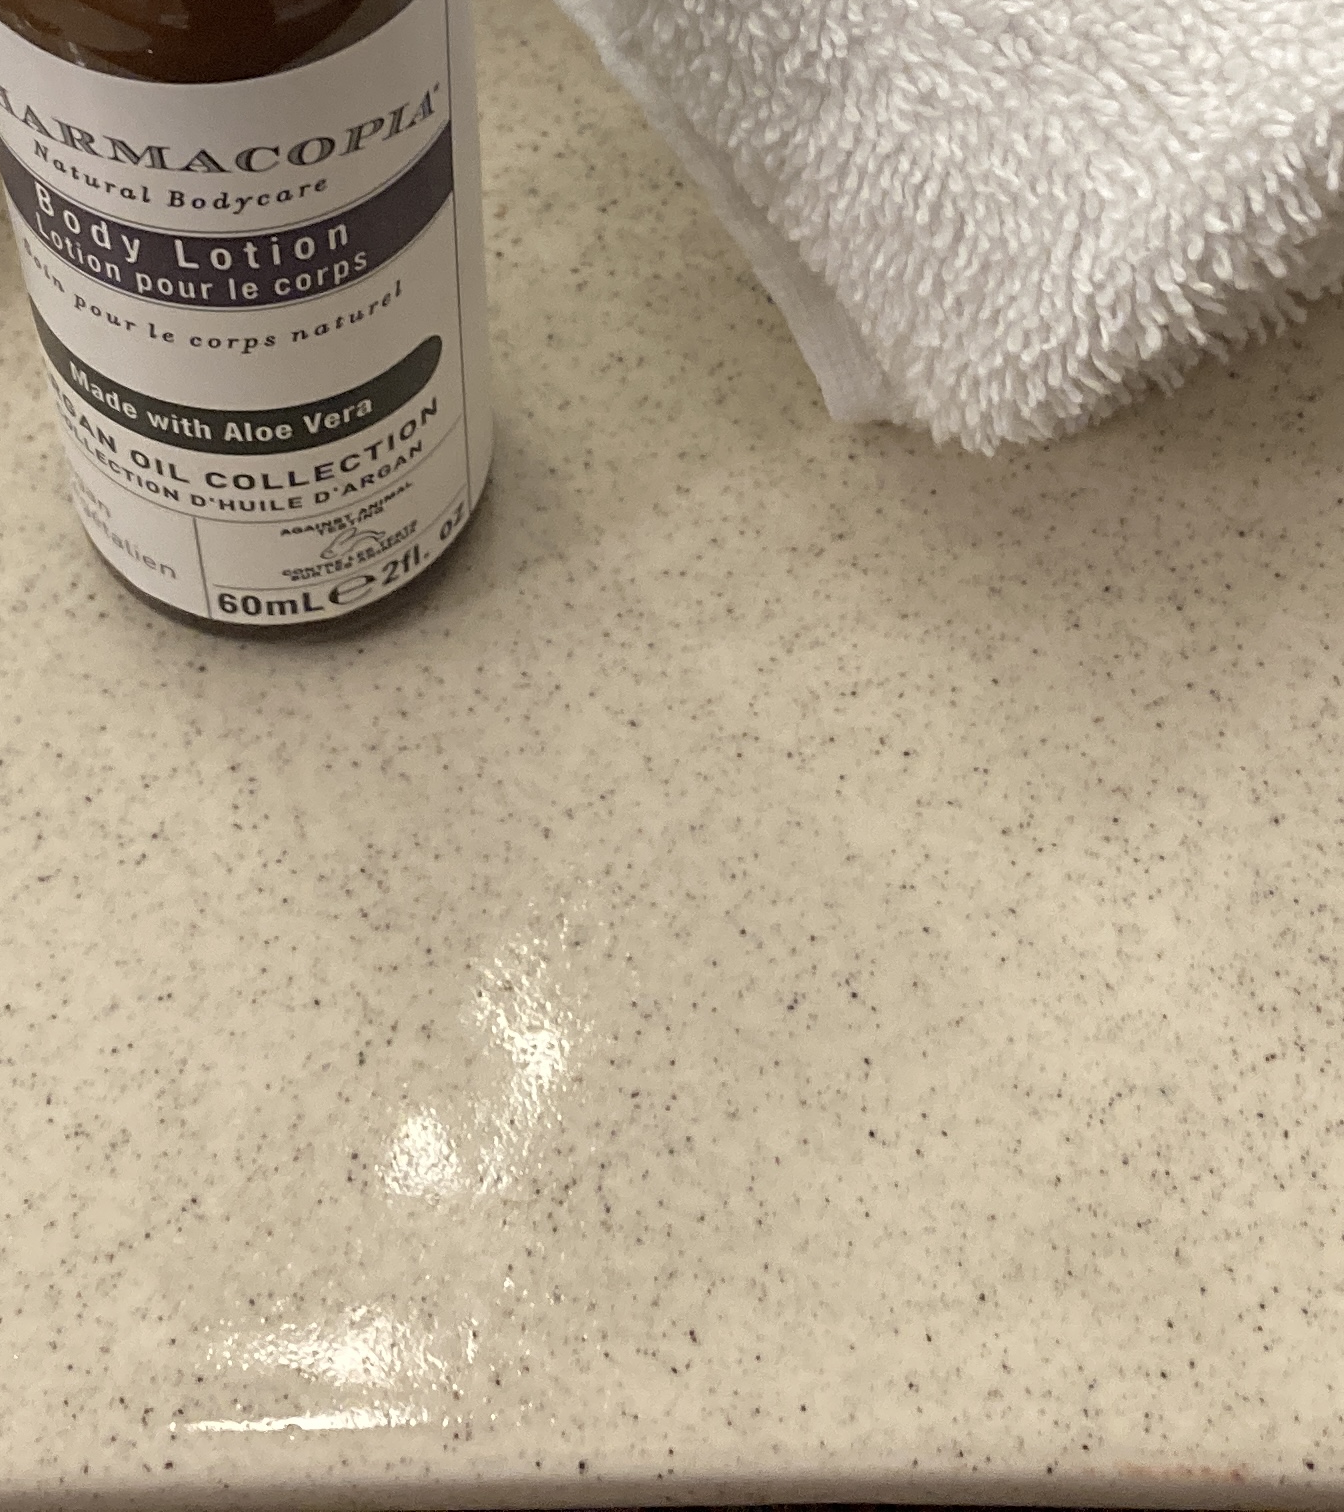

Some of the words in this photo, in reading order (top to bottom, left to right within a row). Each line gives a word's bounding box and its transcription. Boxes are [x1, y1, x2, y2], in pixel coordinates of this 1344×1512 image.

[33, 138, 151, 204] Natural
[168, 177, 329, 215] Bodycare
[33, 179, 142, 264] Body
[173, 222, 350, 271] Lotion
[35, 210, 123, 283] Lotion
[134, 271, 213, 301] pour
[227, 276, 260, 301] le
[273, 250, 368, 296] corps
[73, 292, 138, 332] pour
[147, 321, 176, 344] le
[189, 334, 277, 355] corps
[290, 278, 404, 344] naturel
[68, 359, 139, 420] Made
[147, 411, 213, 441] with
[223, 422, 295, 443] Aloe
[302, 397, 374, 435] Vera
[130, 449, 191, 485] OIL
[204, 395, 439, 491] COLLECTION
[190, 492, 305, 513] D'HUILE
[314, 439, 424, 505] D'ARGAN
[217, 591, 326, 617] 60mL
